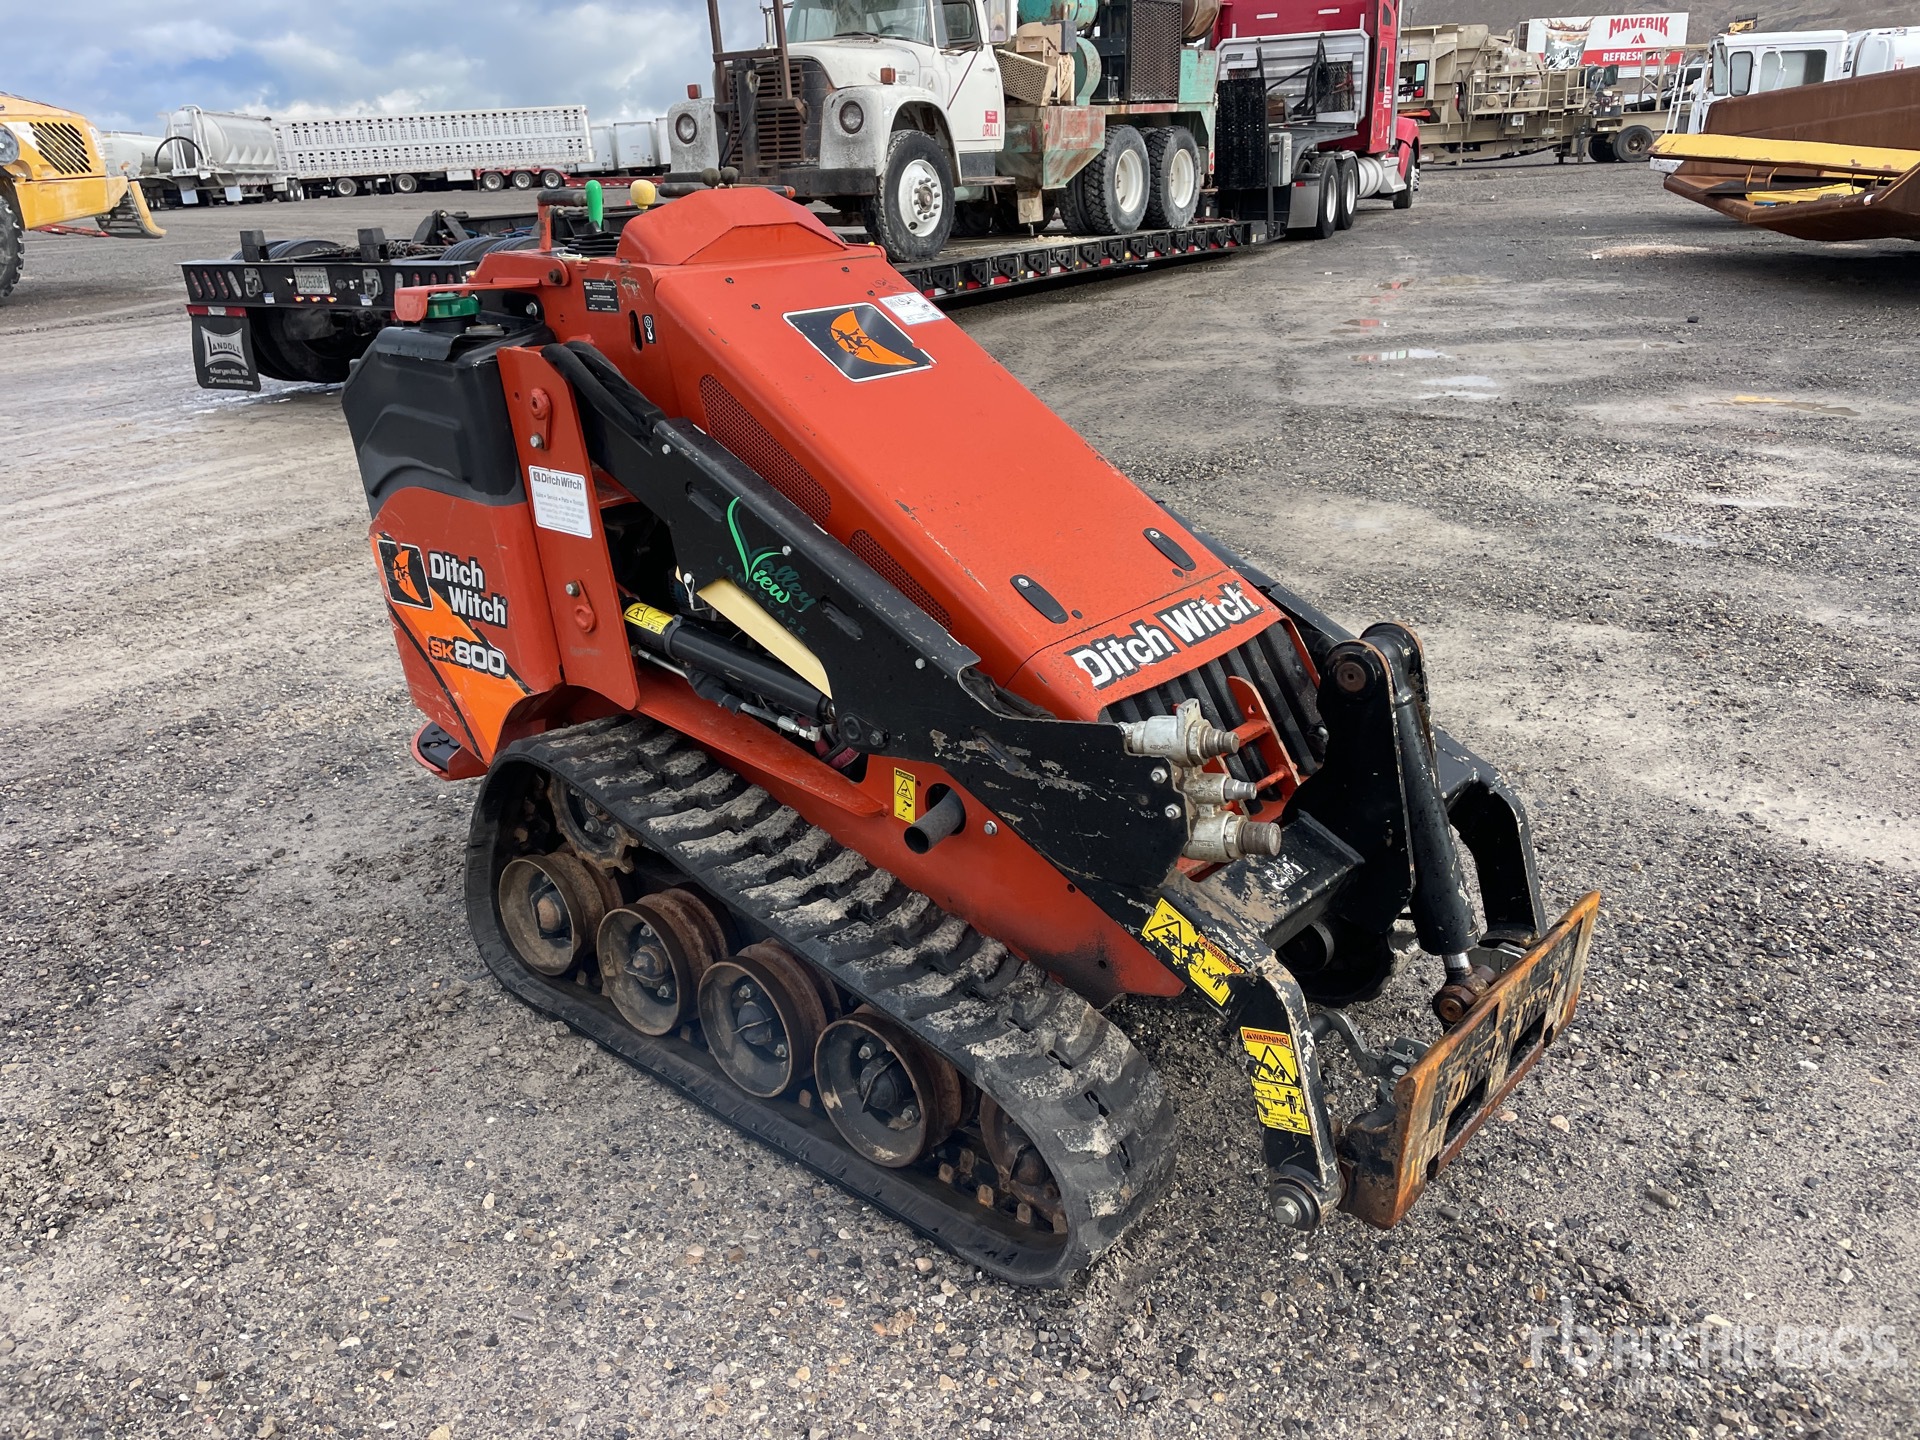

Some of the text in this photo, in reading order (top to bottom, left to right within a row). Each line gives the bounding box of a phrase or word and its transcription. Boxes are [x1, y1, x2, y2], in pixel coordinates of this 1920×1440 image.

[1608, 16, 1670, 40] MAVERIK
[1602, 51, 1643, 62] REFRESH
[207, 336, 243, 360] LANDOLL
[541, 472, 582, 490] Ditch Witch
[429, 552, 484, 589] Ditch
[447, 585, 507, 626] Witch
[717, 555, 808, 636] LANDSCAPE
[1070, 582, 1260, 688] Ditch Witch
[429, 639, 506, 676] SK800
[1206, 943, 1239, 974] WARNING
[1252, 1032, 1289, 1046] WARNING
